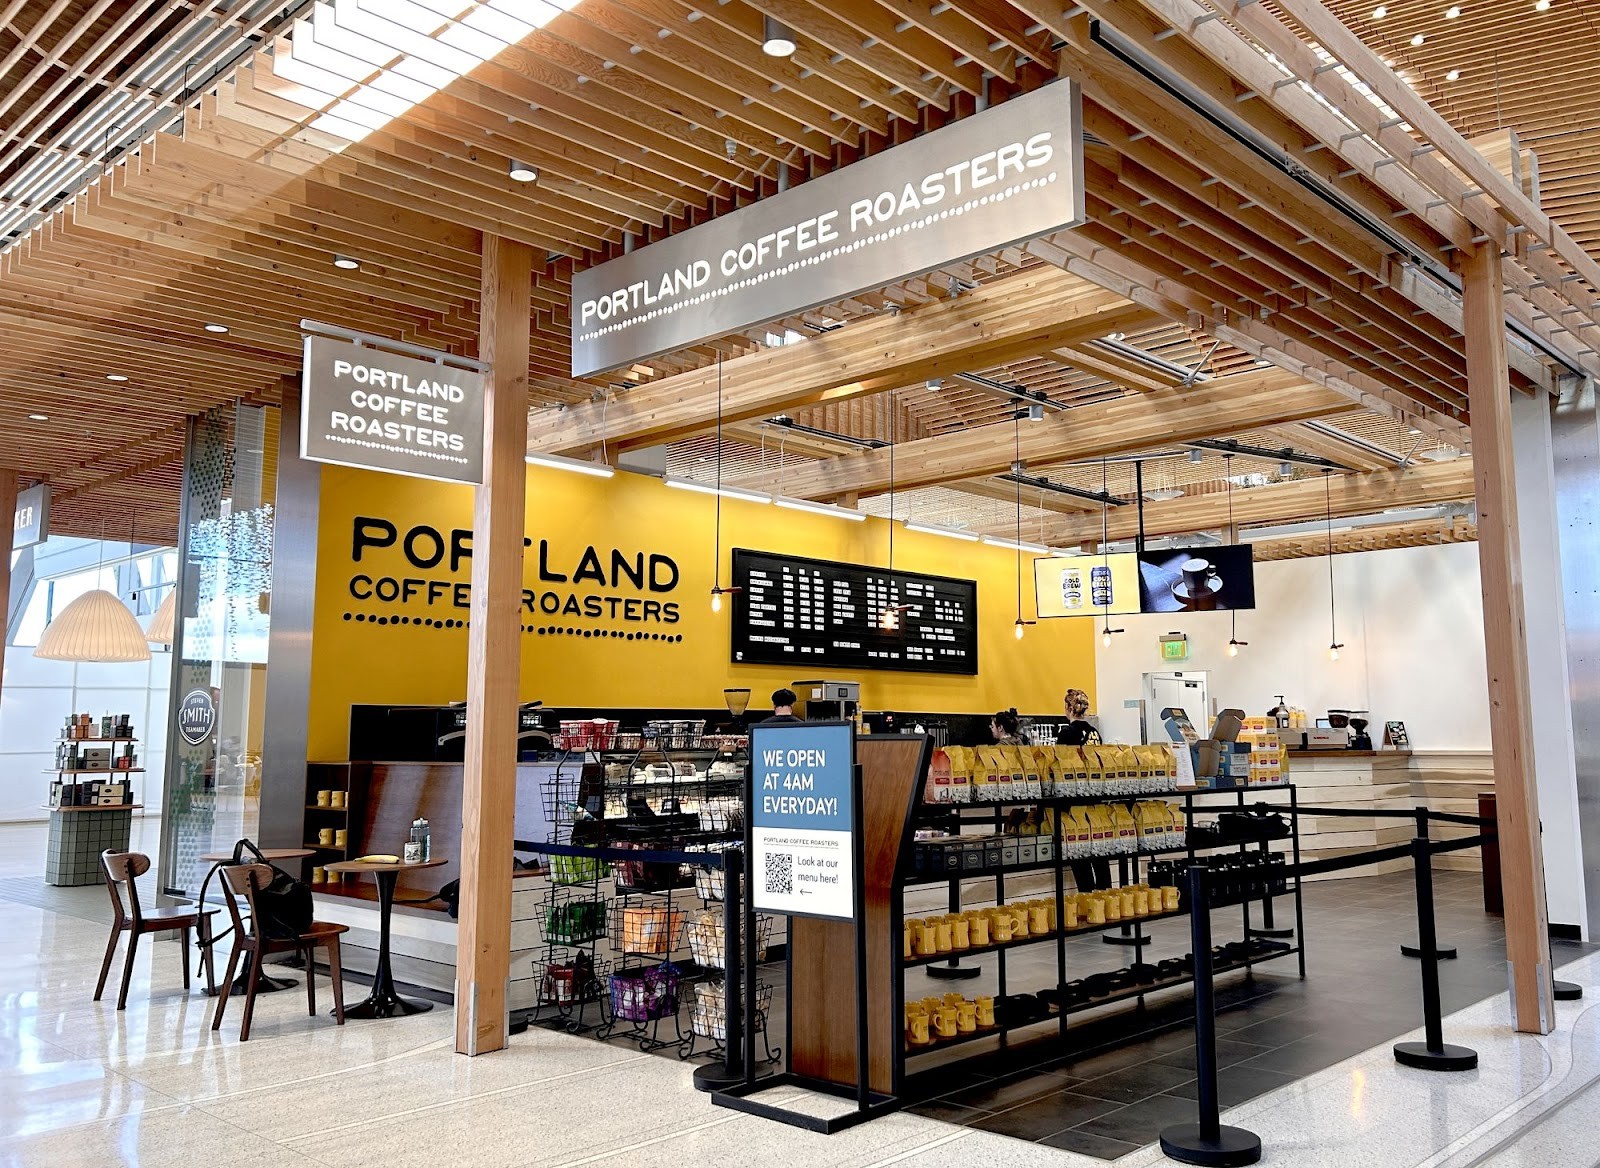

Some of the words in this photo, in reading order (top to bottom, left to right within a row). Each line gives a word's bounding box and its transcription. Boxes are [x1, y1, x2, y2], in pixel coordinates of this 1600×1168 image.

[581, 260, 711, 327] PORTLAND
[720, 210, 840, 278] COFFEE
[850, 132, 1054, 233] ROASTERS
[334, 360, 465, 404] PORTLAND
[350, 390, 450, 426] COFFEE
[330, 411, 465, 452] ROASTERS
[351, 516, 680, 593] POLAND
[349, 574, 472, 609] COFFE
[182, 707, 211, 725] SMITH
[763, 749, 784, 767] WE
[786, 749, 826, 767] OPEN
[763, 773, 780, 790] AT
[783, 773, 814, 791] 4AM
[763, 796, 838, 816] EVERYDAY!
[763, 836, 789, 844] PORTLAND
[789, 838, 810, 846] COFFEE
[810, 839, 839, 847] ROASTERS
[797, 856, 815, 867] Look
[816, 858, 824, 868] at
[825, 860, 838, 868] our
[798, 873, 818, 883] menu
[819, 872, 839, 885] here!
